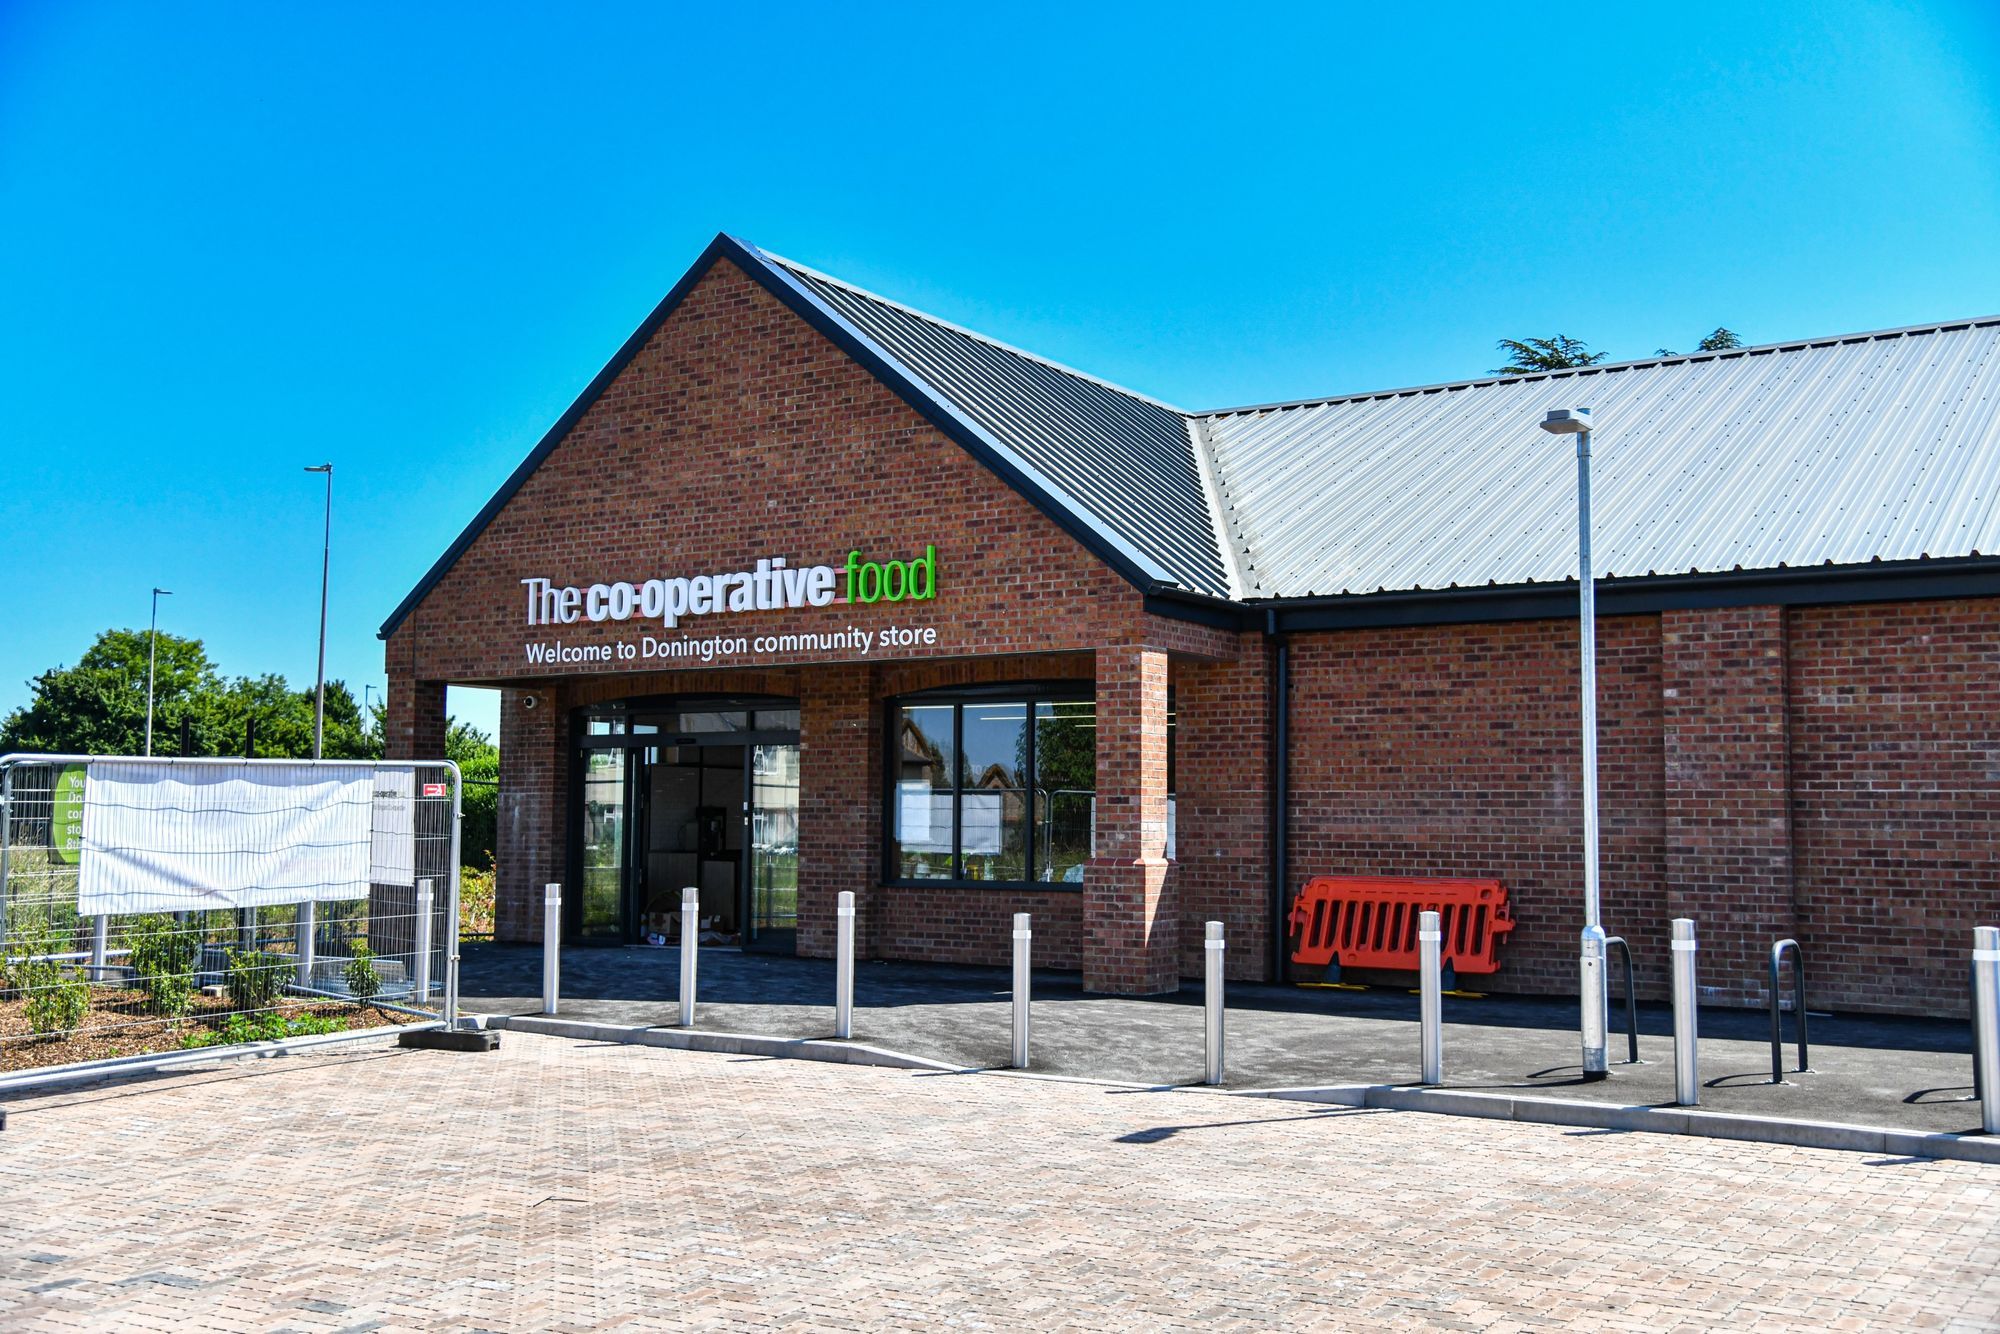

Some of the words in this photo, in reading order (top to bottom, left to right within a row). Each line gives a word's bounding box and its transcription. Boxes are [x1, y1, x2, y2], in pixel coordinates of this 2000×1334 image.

[521, 578, 582, 626] The
[586, 557, 836, 628] co-operative
[844, 545, 937, 604] food
[526, 640, 612, 664] Welcome
[617, 640, 636, 660] to
[642, 634, 748, 662] Donington
[753, 625, 874, 655] community
[879, 626, 937, 646] store
